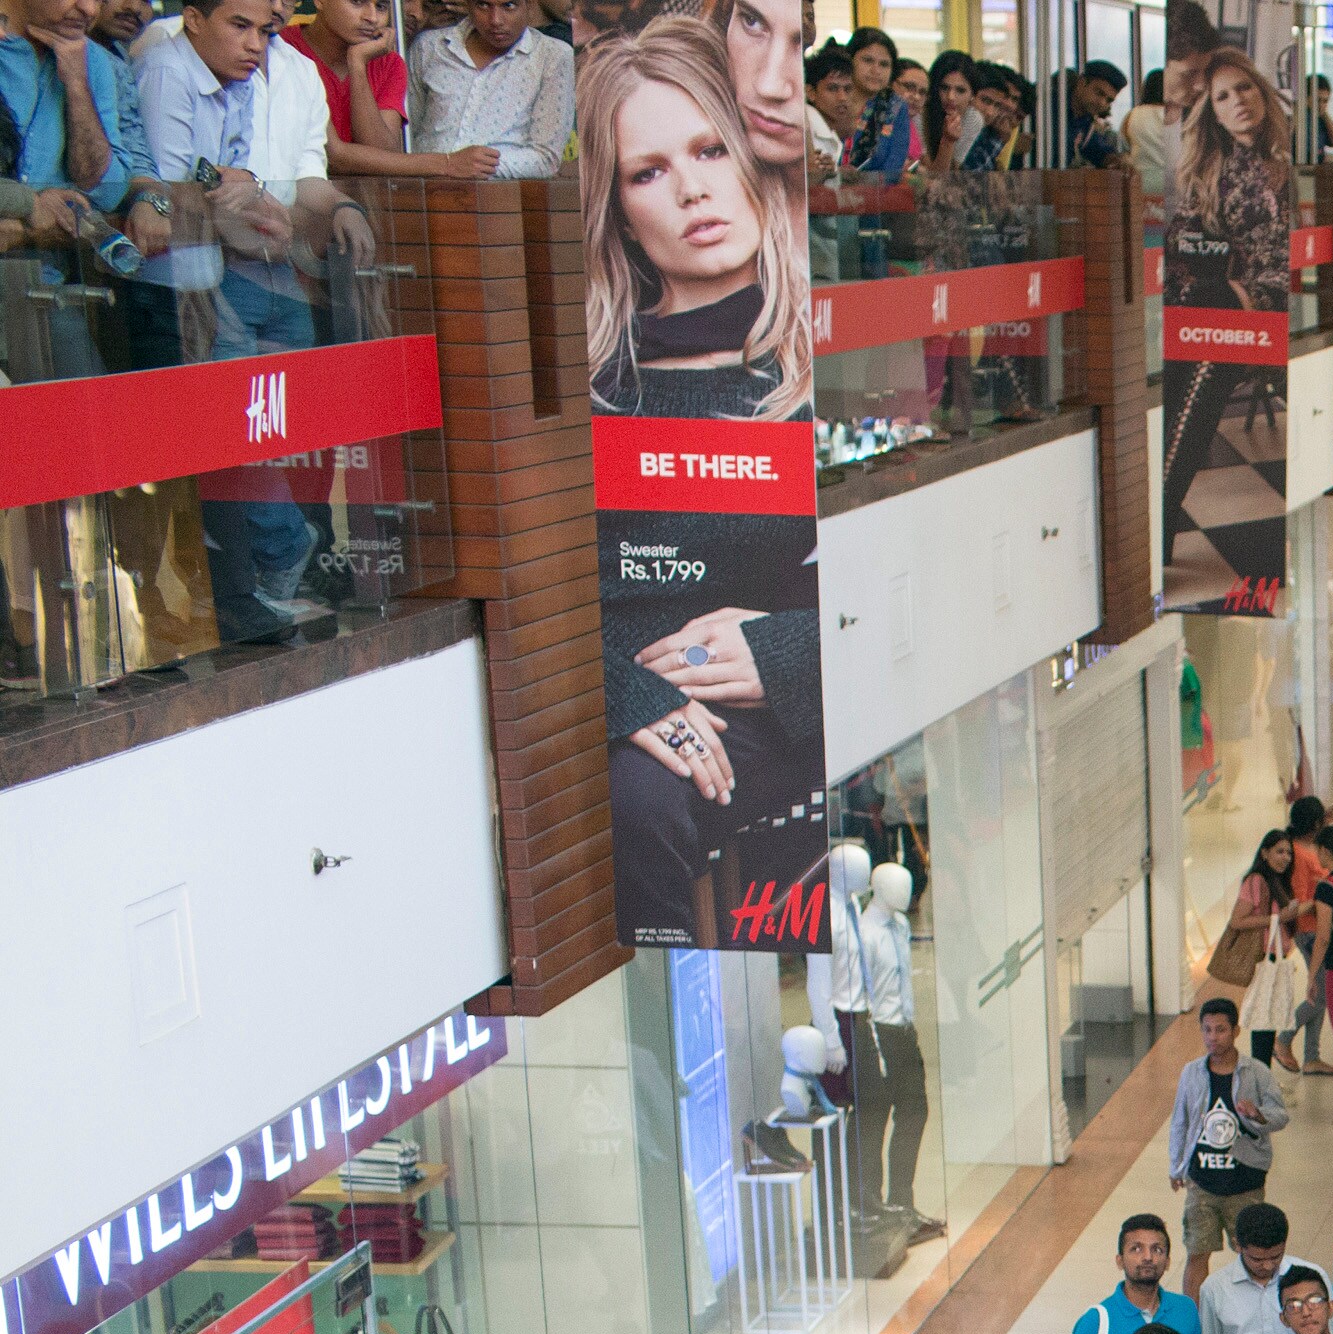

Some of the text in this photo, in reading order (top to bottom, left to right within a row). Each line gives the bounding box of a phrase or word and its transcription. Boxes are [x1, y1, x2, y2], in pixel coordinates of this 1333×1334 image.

[1179, 326, 1272, 347] OCTOBER 2.
[245, 371, 286, 444] H&M
[640, 452, 779, 481] BE THERE.
[619, 541, 679, 558] Sweater
[730, 880, 826, 945] H&M
[1197, 1152, 1235, 1169] YEEZ
[54, 1146, 244, 1306] WILLS
